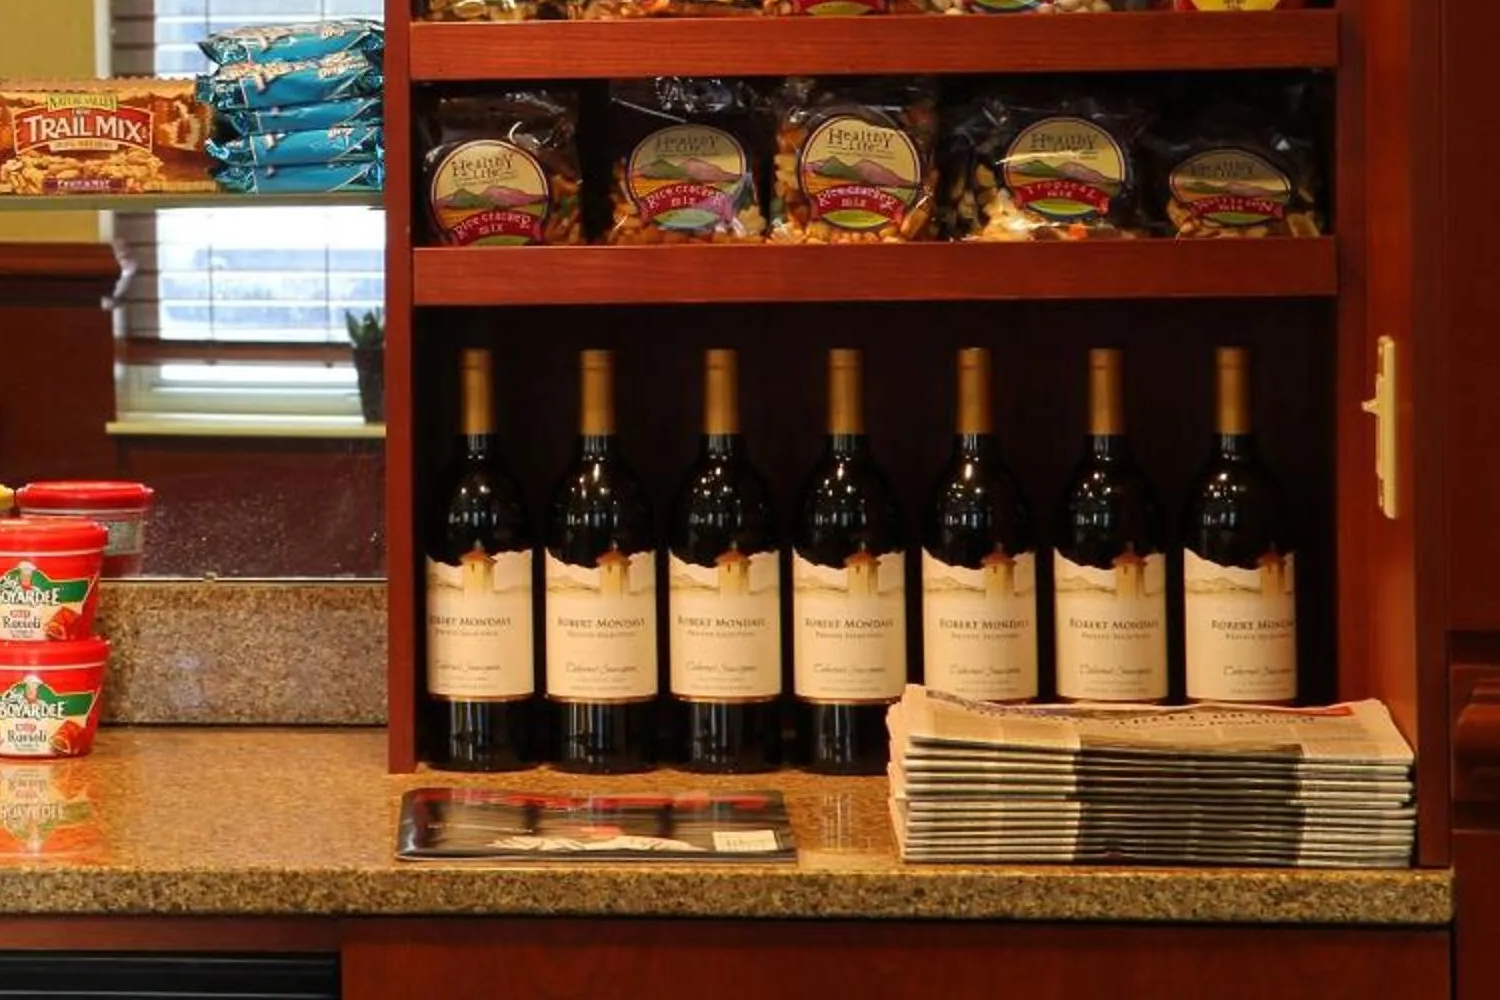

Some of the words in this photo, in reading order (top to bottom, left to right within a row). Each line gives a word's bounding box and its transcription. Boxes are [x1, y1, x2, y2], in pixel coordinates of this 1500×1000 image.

[22, 114, 92, 143] TRAIL
[94, 115, 144, 143] MIX
[828, 128, 895, 149] Healthy
